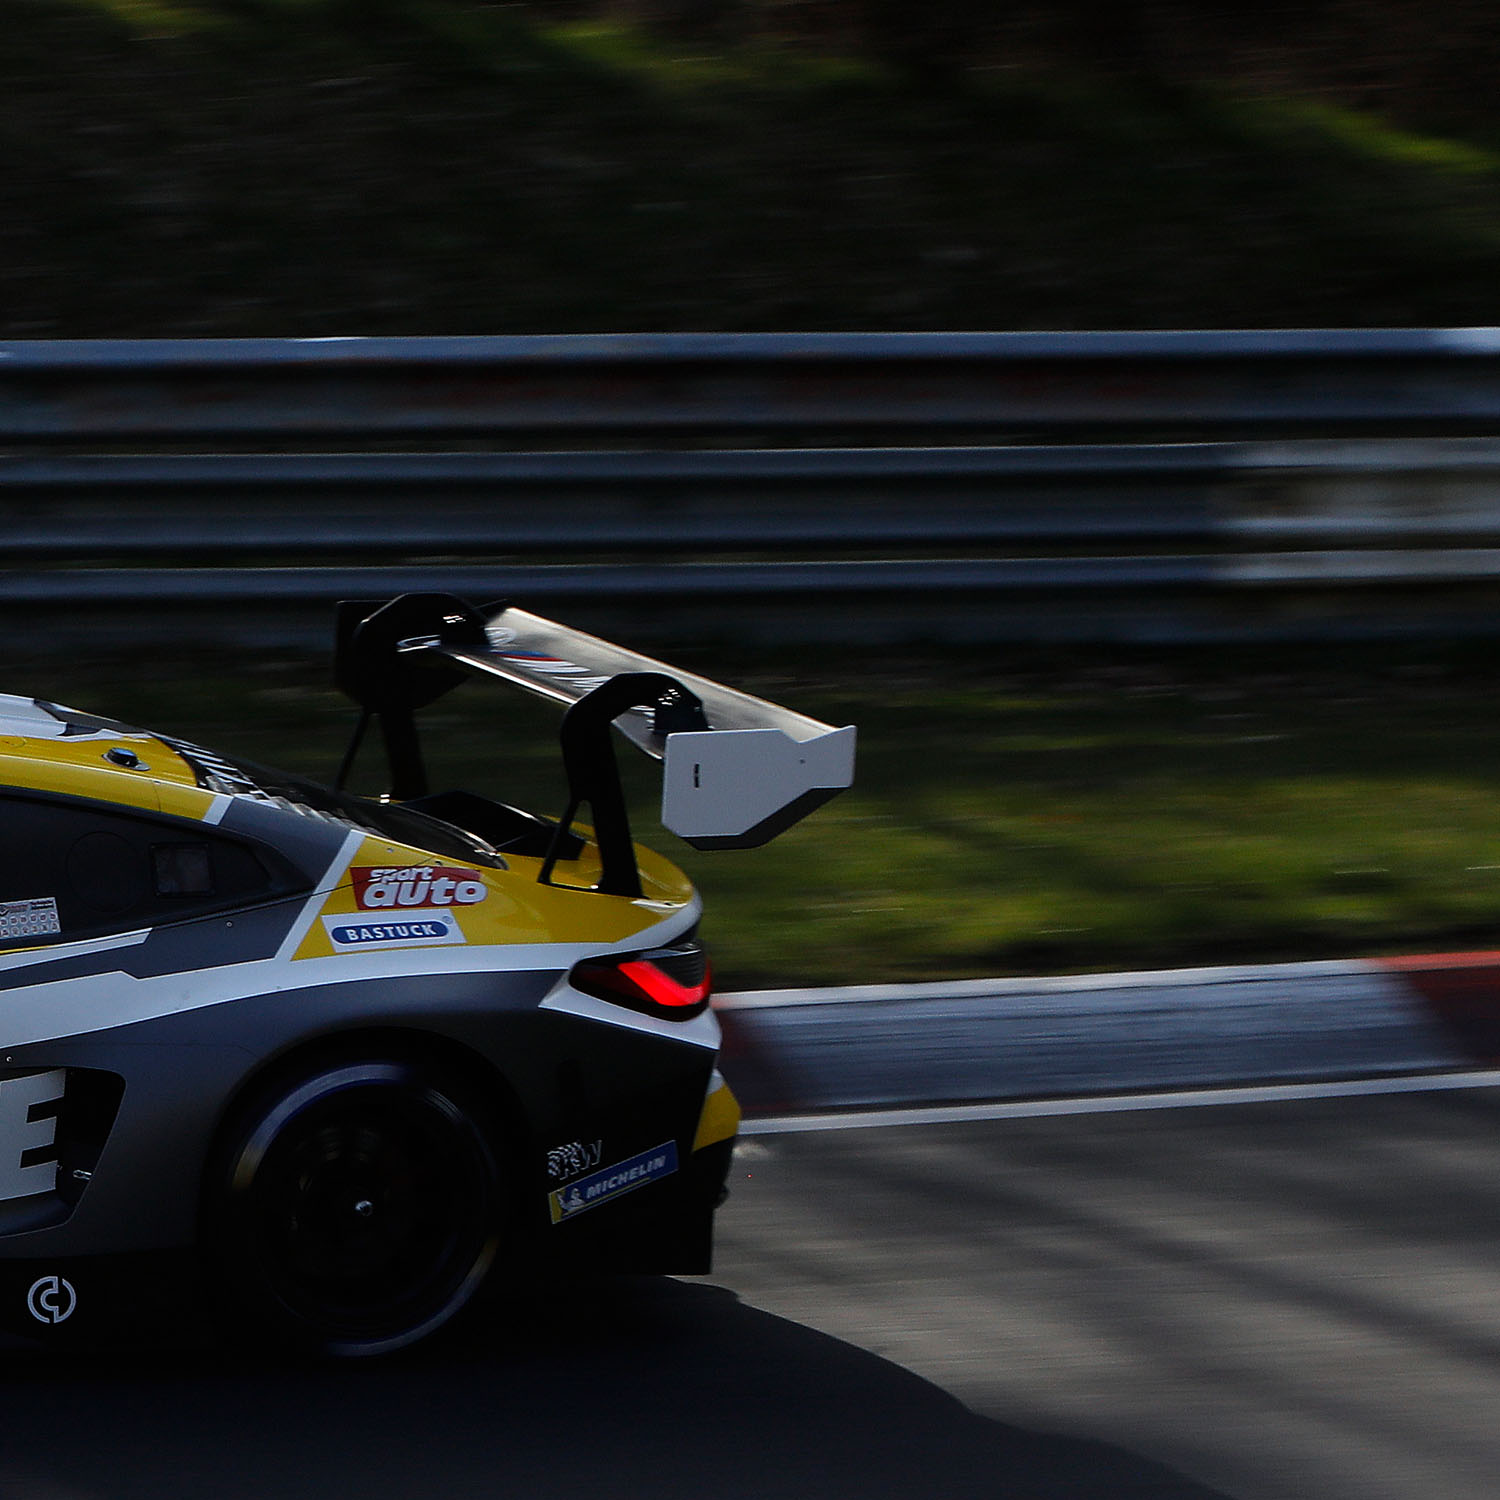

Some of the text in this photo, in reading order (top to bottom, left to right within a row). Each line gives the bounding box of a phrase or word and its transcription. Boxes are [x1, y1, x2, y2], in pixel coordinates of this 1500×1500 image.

[369, 867, 433, 883] sport
[362, 877, 487, 907] auto
[346, 923, 436, 941] BASTUCK
[585, 1155, 667, 1198] MICHELIN
